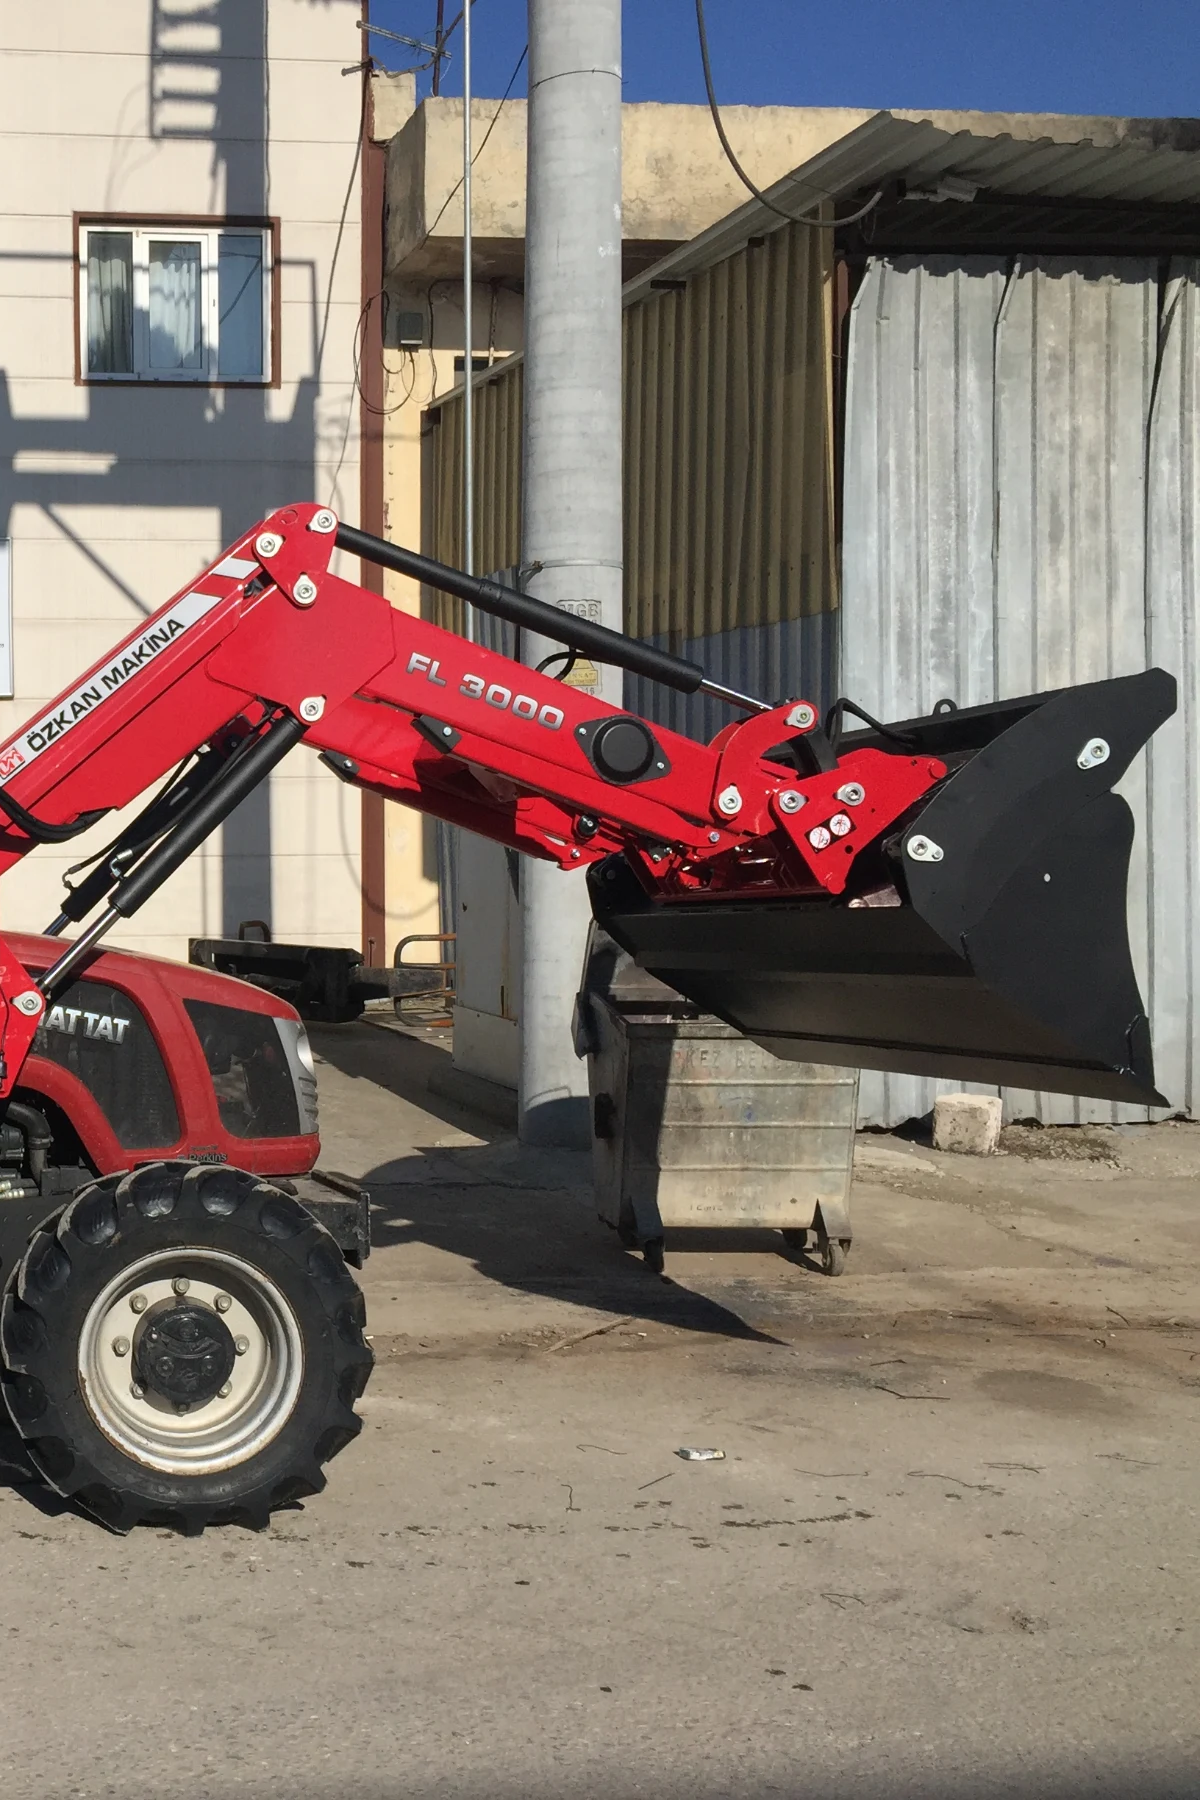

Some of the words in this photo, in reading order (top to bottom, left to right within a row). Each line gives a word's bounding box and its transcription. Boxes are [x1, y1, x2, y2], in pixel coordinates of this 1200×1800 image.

[26, 686, 103, 752] ÖZKAN
[100, 618, 185, 691] MAKİNA
[406, 652, 447, 687] FL
[459, 673, 565, 731] 3000
[189, 1152, 227, 1162] Perkins
